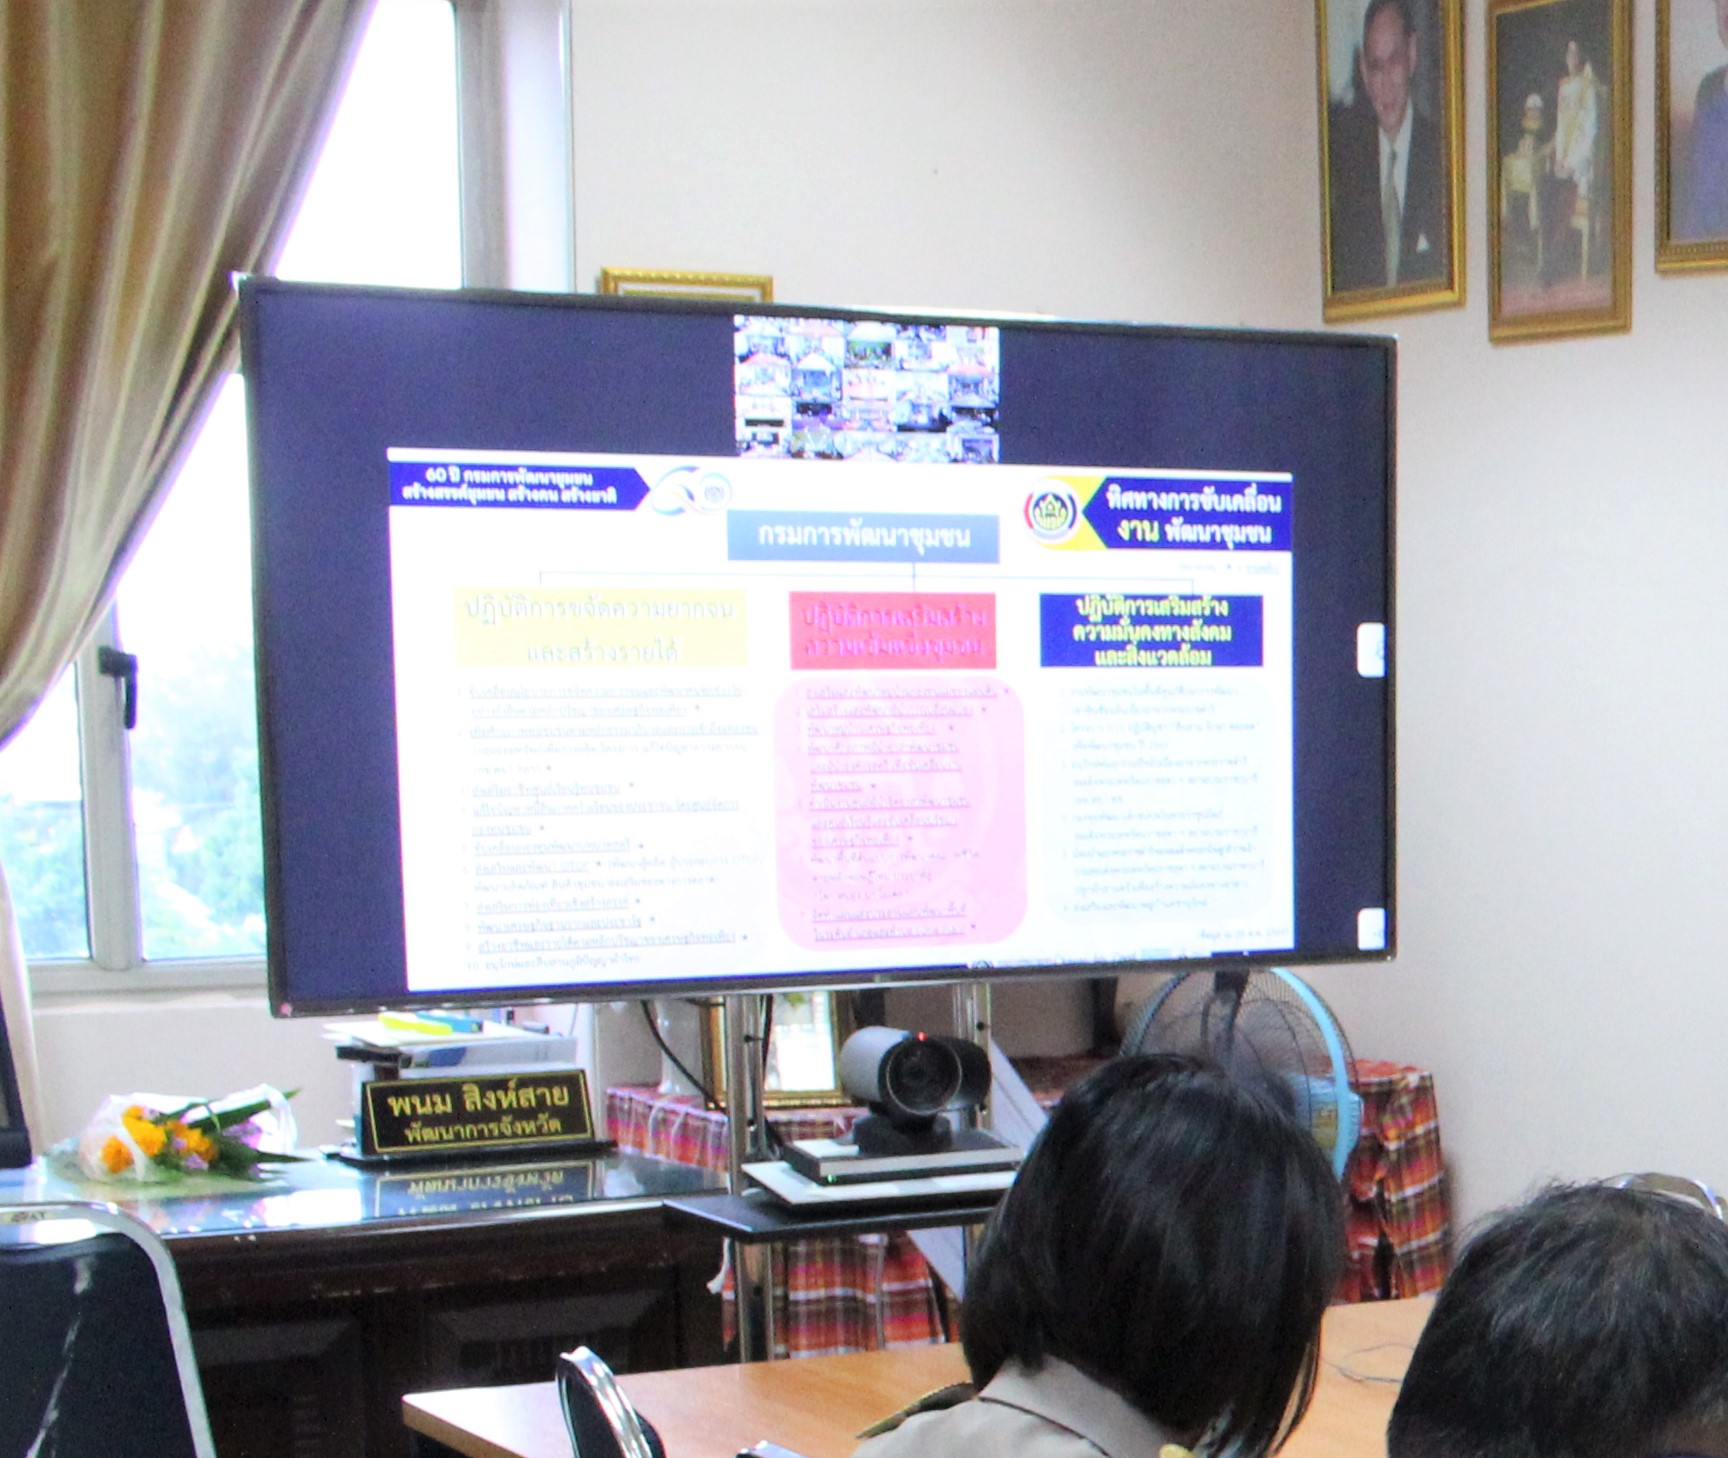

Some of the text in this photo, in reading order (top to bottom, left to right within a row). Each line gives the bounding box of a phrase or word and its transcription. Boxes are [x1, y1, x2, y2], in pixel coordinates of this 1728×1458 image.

[425, 466, 594, 489] 60 ปี กรมการพัฒนาชุมชน
[1105, 483, 1282, 513] ทิศทางการขับเคลื่อน
[758, 517, 971, 556] กรมการพัฒนาชุมชน
[1117, 516, 1273, 550] งาน พัฒนาชุมชน
[464, 593, 734, 625] ปฏิบัติการขจัดความยากจน
[1076, 594, 1229, 622] ปฏิบัติการเสริมสร้าง
[1072, 617, 1233, 645] ความมั่นคงทางสังคม
[527, 638, 679, 663] และสร้างรายได้
[1094, 643, 1213, 667] และสิ่งแวดล้อม
[387, 1078, 570, 1117] พนม สิงห์สาย
[404, 1112, 562, 1144] พัฒนาการจังหวัด
